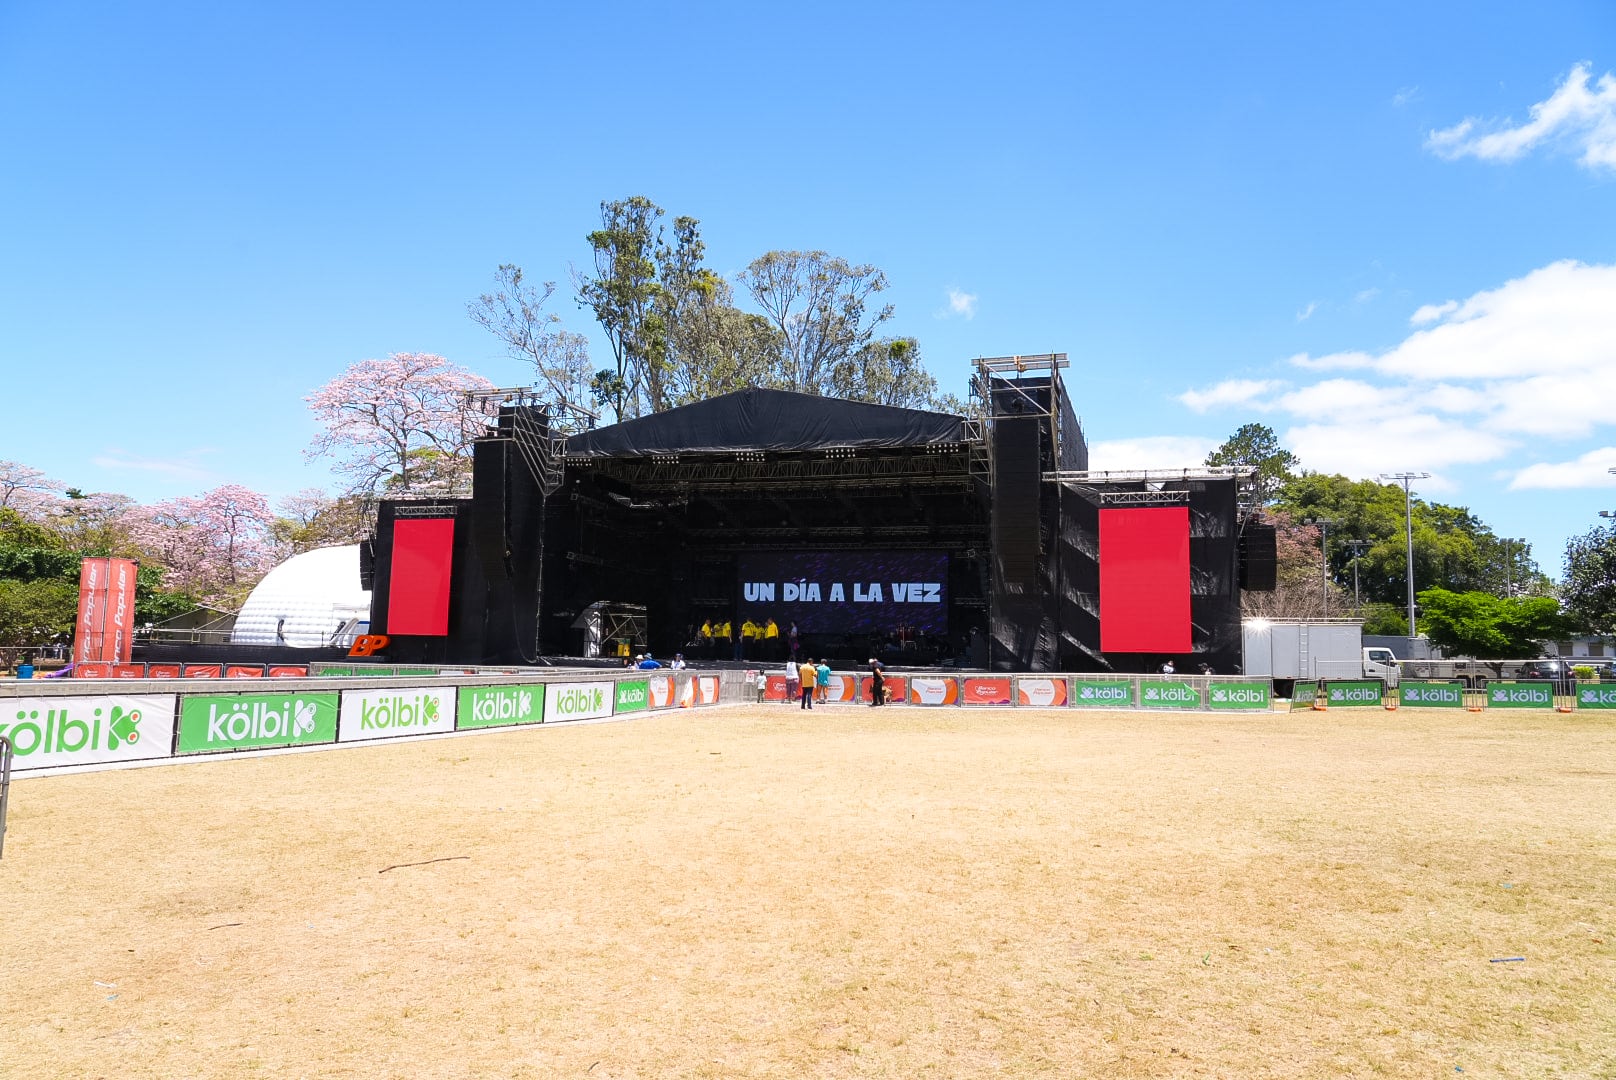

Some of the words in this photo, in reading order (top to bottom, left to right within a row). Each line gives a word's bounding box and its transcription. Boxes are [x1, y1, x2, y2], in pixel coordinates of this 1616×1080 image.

[84, 563, 97, 626] Popular
[114, 563, 127, 627] Popular
[743, 583, 775, 602] UN
[783, 578, 822, 602] DÍA
[829, 583, 845, 602] A
[853, 583, 883, 602] LA
[891, 583, 941, 603] VEZ
[347, 634, 391, 656] BP
[556, 688, 592, 714] kölbi
[1095, 687, 1127, 699] kölbi
[1228, 689, 1264, 702] kölbi
[1345, 688, 1378, 701] kölbi
[1421, 688, 1458, 702] kölbi
[1509, 689, 1548, 702] kölbi
[360, 695, 420, 731] kölbi
[472, 691, 518, 721] kölbi
[0, 707, 102, 756] ölbi
[207, 701, 290, 742] kölbi
